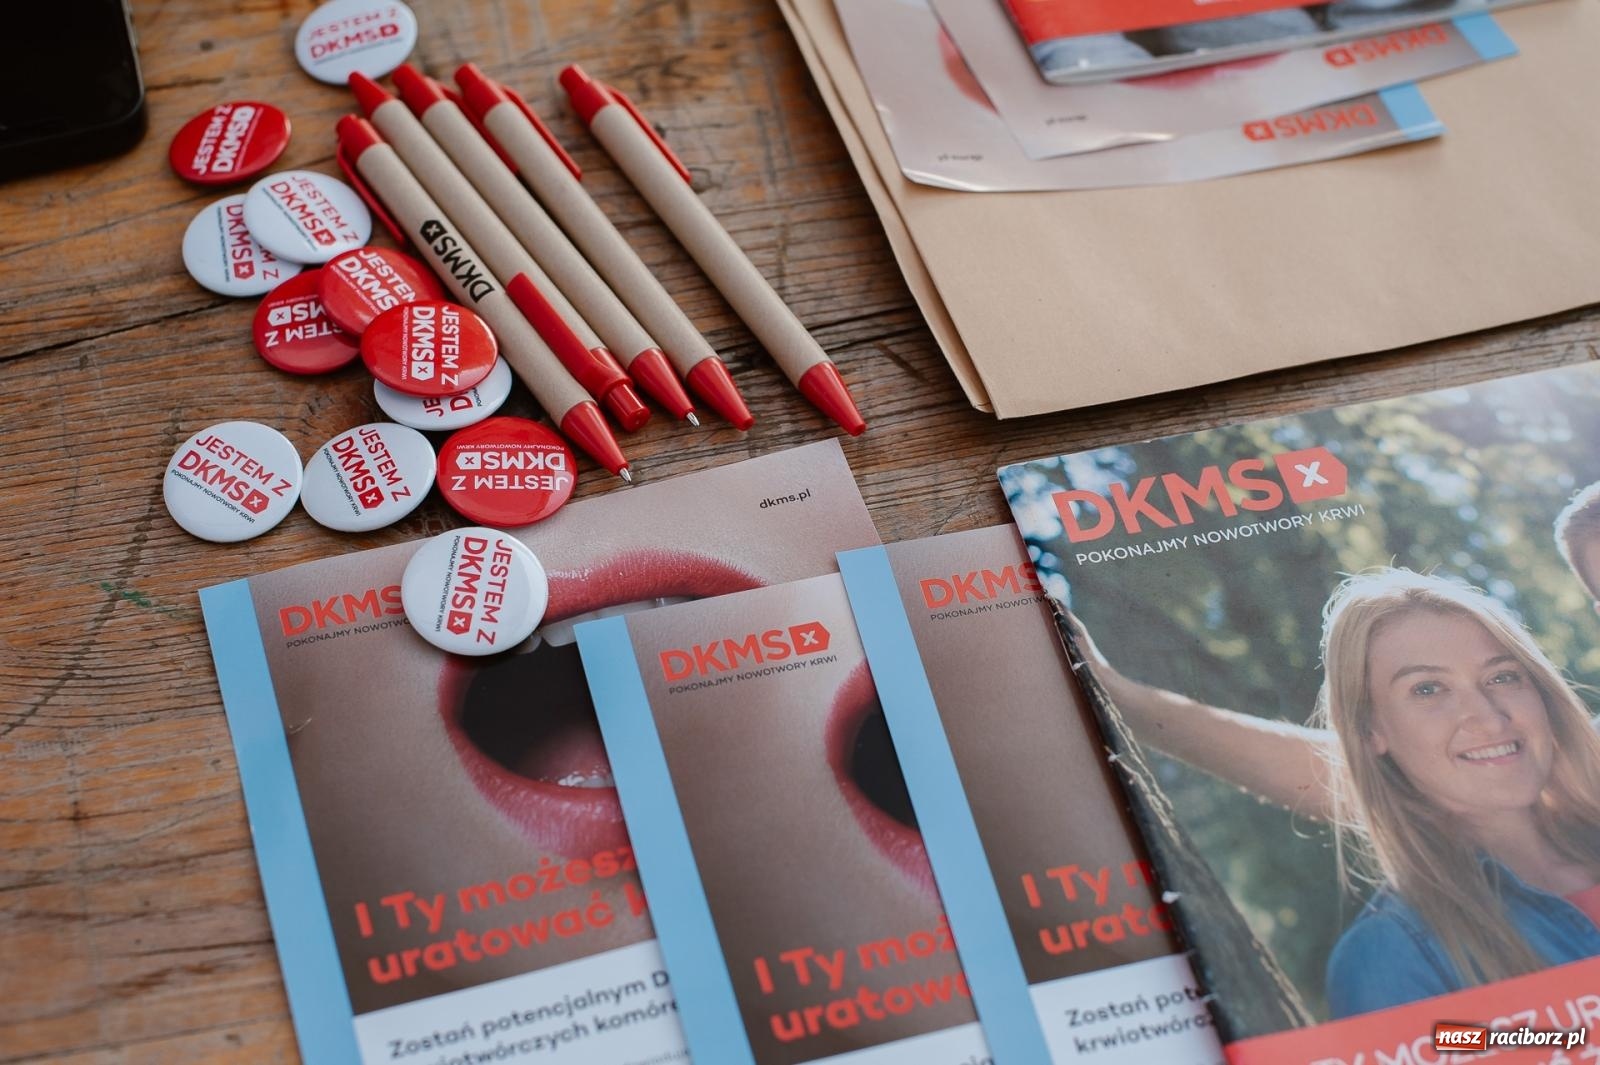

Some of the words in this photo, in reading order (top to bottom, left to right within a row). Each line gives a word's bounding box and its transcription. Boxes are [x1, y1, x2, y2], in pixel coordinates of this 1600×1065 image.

[311, 27, 379, 58] DKMS
[1352, 21, 1448, 62] DKMS
[192, 115, 228, 176] JESTEM
[211, 119, 251, 172] DKMS
[1273, 103, 1379, 138] DKMS
[270, 181, 324, 232] DKMS
[292, 176, 348, 230] JESTEM
[342, 230, 359, 243] Z
[226, 204, 253, 261] DKMS
[262, 268, 280, 281] Z
[337, 256, 400, 311] DKMS
[433, 235, 496, 304] DKMS
[265, 331, 280, 348] Z
[411, 306, 436, 362] DKMS
[441, 306, 460, 369] JESTEM
[441, 372, 460, 387] Z
[177, 449, 251, 502] DKMS
[195, 435, 275, 485] JESTEM
[271, 478, 293, 497] Z
[332, 435, 376, 493] DKMS
[359, 429, 403, 486] JESTEM
[391, 485, 411, 502] Z
[451, 475, 467, 490] Z
[474, 474, 569, 491] JESTEM
[482, 451, 566, 470] DKMS
[202, 487, 241, 514] NOWOTWORY
[759, 488, 811, 509] dkms.pl
[1051, 458, 1284, 543] DKMS
[1075, 535, 1188, 566] POKONAJMY
[1193, 511, 1314, 547] NOWOTWORY
[1318, 502, 1366, 523] KRWI
[451, 536, 488, 610] DKMS
[480, 539, 512, 624] JESTEM
[919, 561, 1041, 609] DKMS
[278, 584, 404, 639] DKMS
[286, 629, 352, 649] POKONAJMY
[354, 617, 411, 635] NOWOTWO
[476, 628, 496, 646] Z
[930, 604, 993, 622] POKONAJMY
[659, 629, 792, 682] DKMS
[668, 674, 734, 695] POKONAJMY
[737, 660, 807, 682] NOWOTWORY
[809, 654, 838, 667] KRWI
[1021, 873, 1042, 909] I
[1046, 864, 1111, 907] Ty
[354, 902, 374, 938] I
[381, 891, 447, 934] Ty
[367, 890, 615, 985] uratować
[753, 957, 775, 994] I
[779, 947, 847, 991] Ty
[388, 1021, 475, 1059] Zostań
[481, 979, 647, 1041] potencjalnym
[1064, 994, 1149, 1028] Zostań
